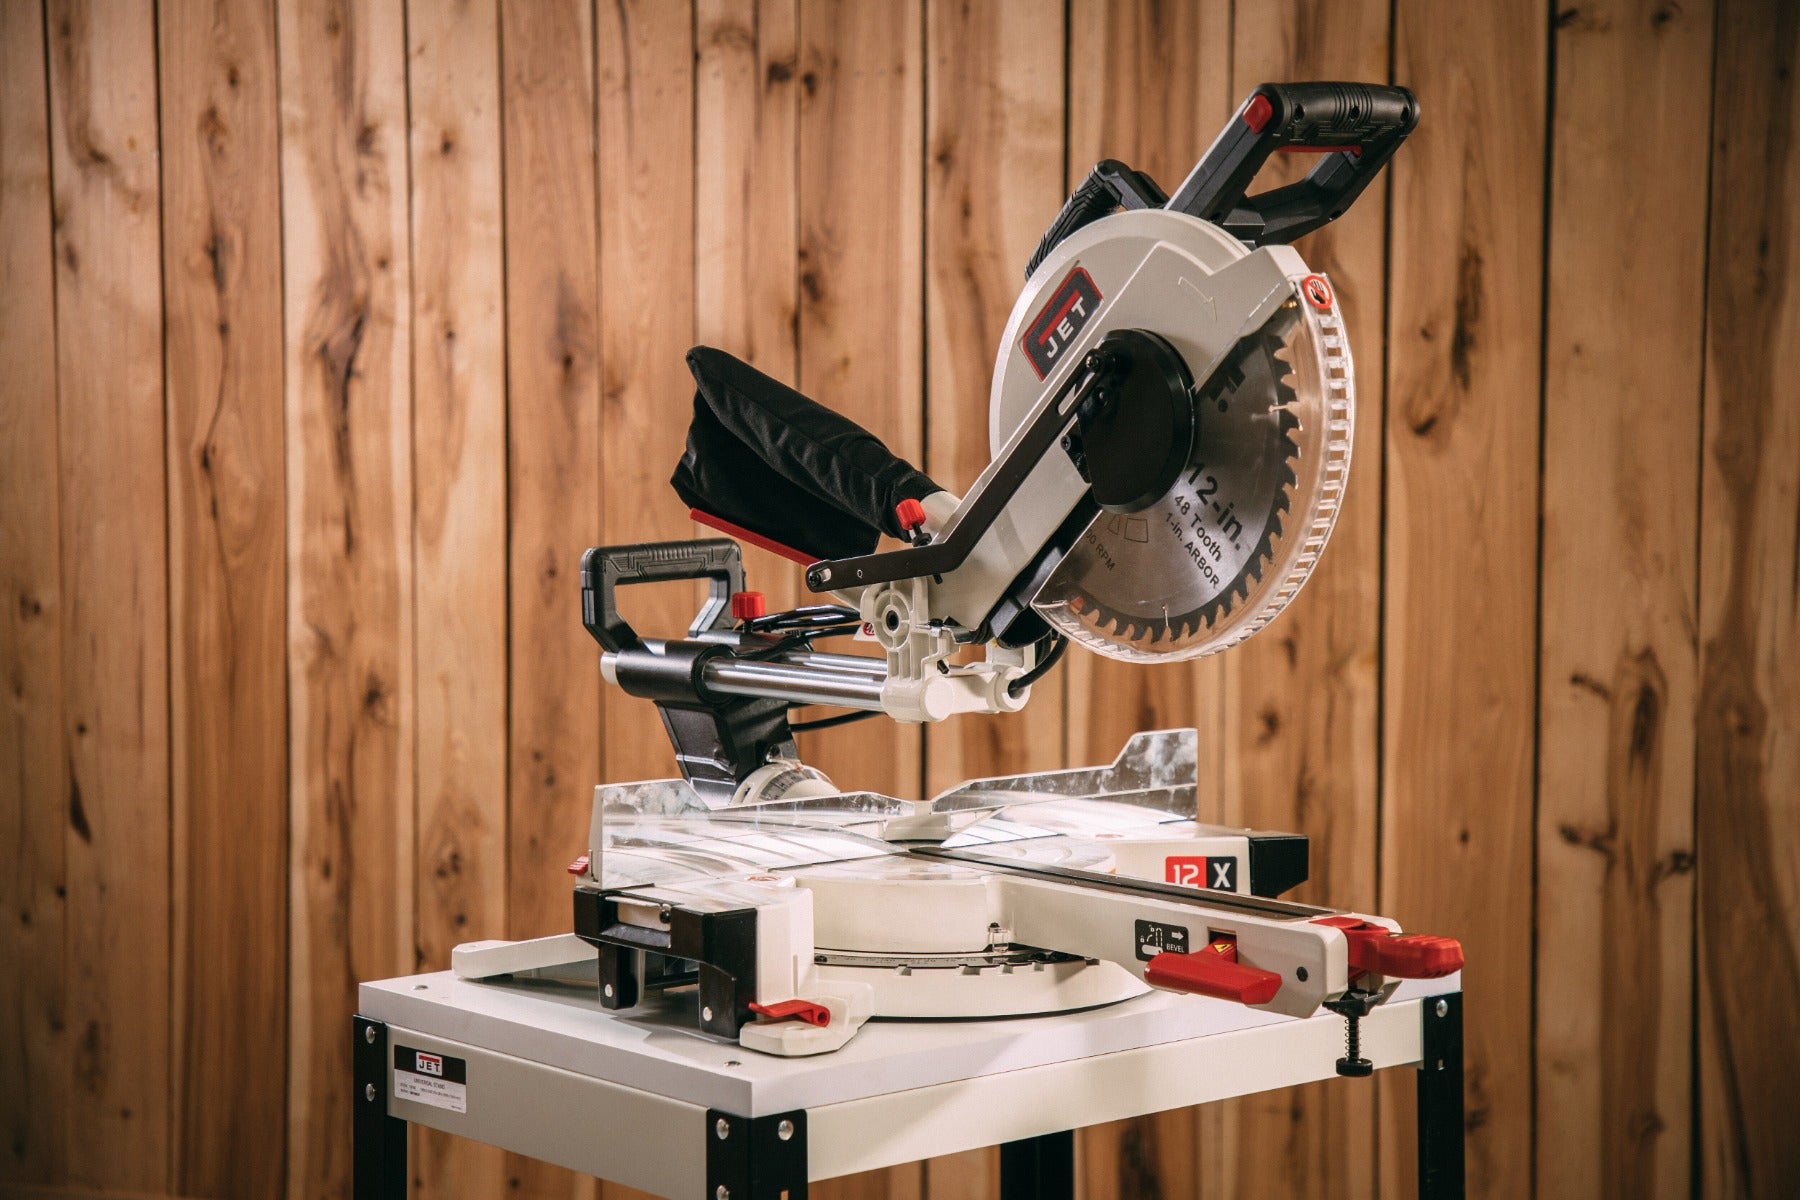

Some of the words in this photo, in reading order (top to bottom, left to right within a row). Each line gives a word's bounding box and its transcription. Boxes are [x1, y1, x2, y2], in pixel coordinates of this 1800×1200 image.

[1047, 296, 1086, 359] JET
[1174, 495, 1191, 516] 48
[1190, 513, 1222, 562] Tooth
[1187, 461, 1243, 551] 12-in.
[1096, 543, 1116, 571] RPM
[1165, 512, 1183, 542] 1-in.
[1184, 541, 1220, 589] ARBOR
[1173, 864, 1200, 889] 12
[1213, 863, 1231, 888] X
[1166, 943, 1185, 954] BEVEL
[419, 1061, 440, 1073] JET
